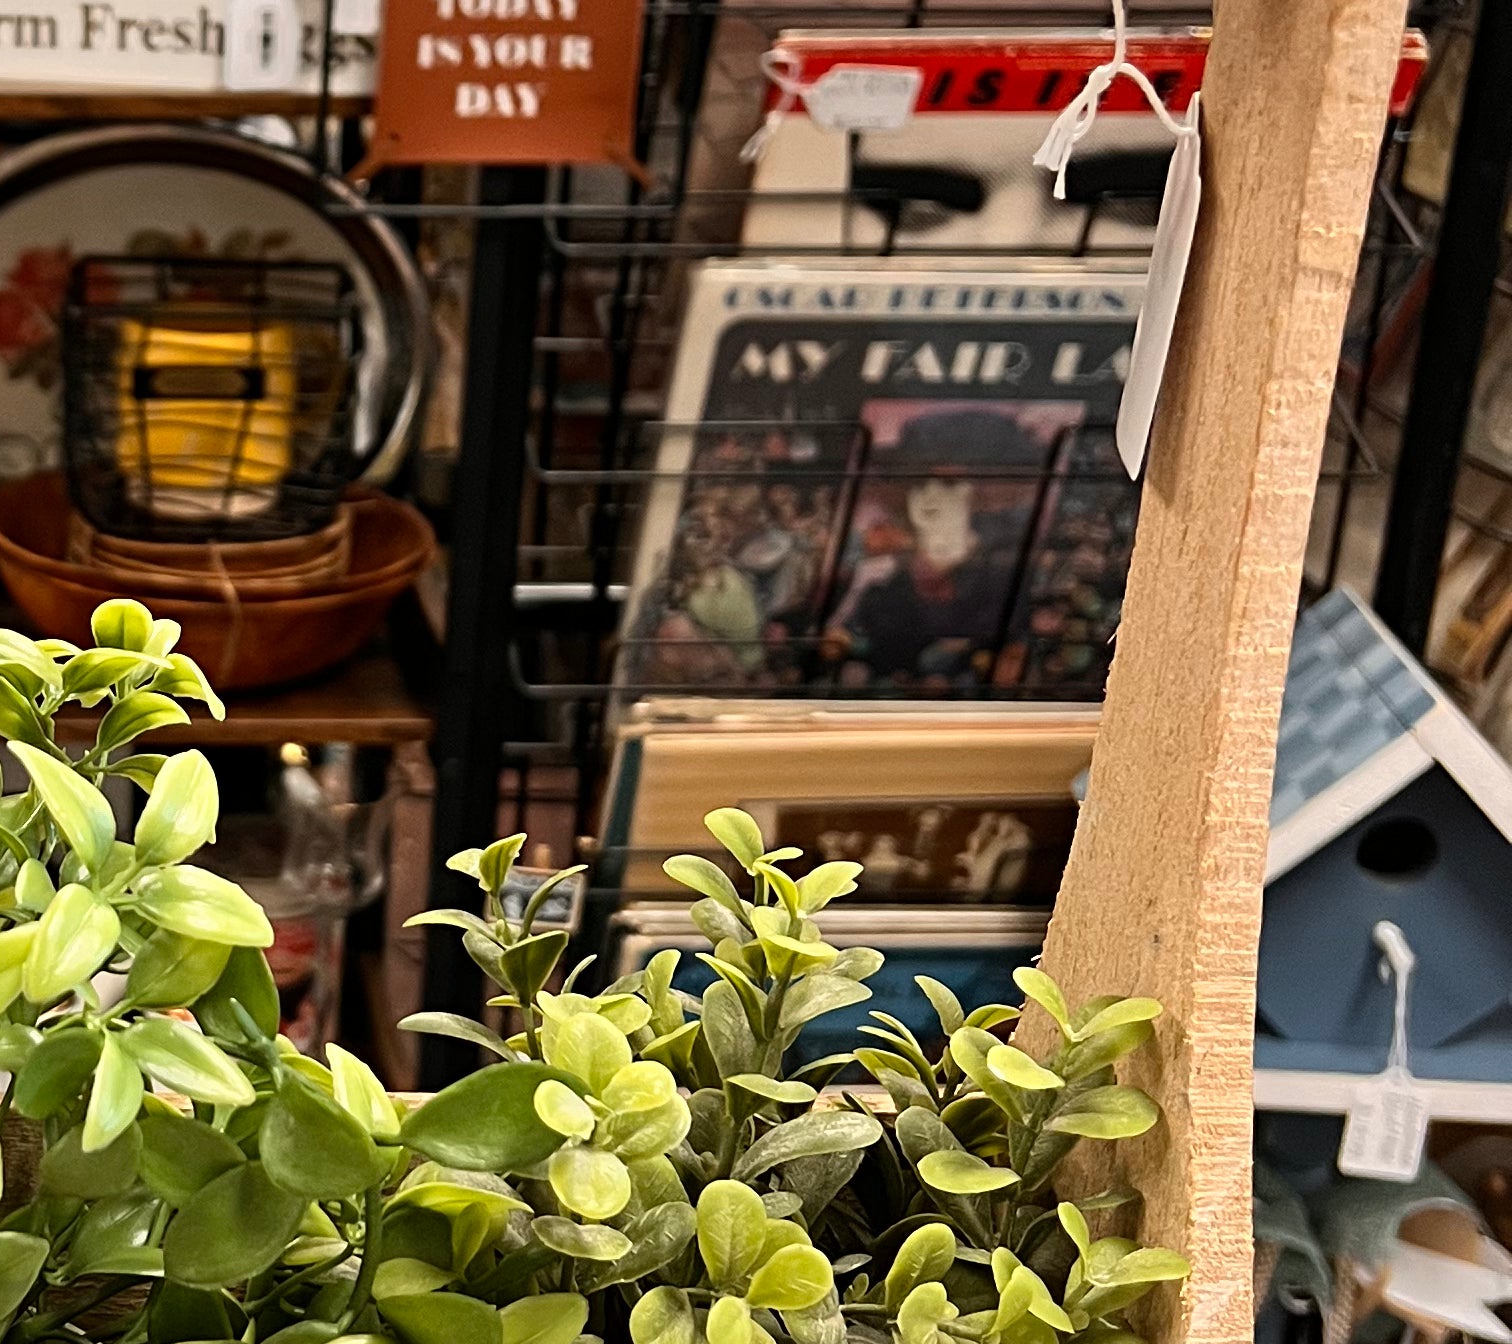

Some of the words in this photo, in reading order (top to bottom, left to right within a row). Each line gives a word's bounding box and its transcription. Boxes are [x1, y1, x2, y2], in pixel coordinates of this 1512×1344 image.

[79, 2, 226, 56] Fresh
[416, 33, 464, 70] IS
[467, 32, 594, 71] YOUR
[453, 81, 548, 119] DAY
[928, 68, 1008, 107] IS
[730, 341, 850, 385] MY
[859, 340, 1033, 386] FAIR
[1049, 341, 1132, 386] LA
